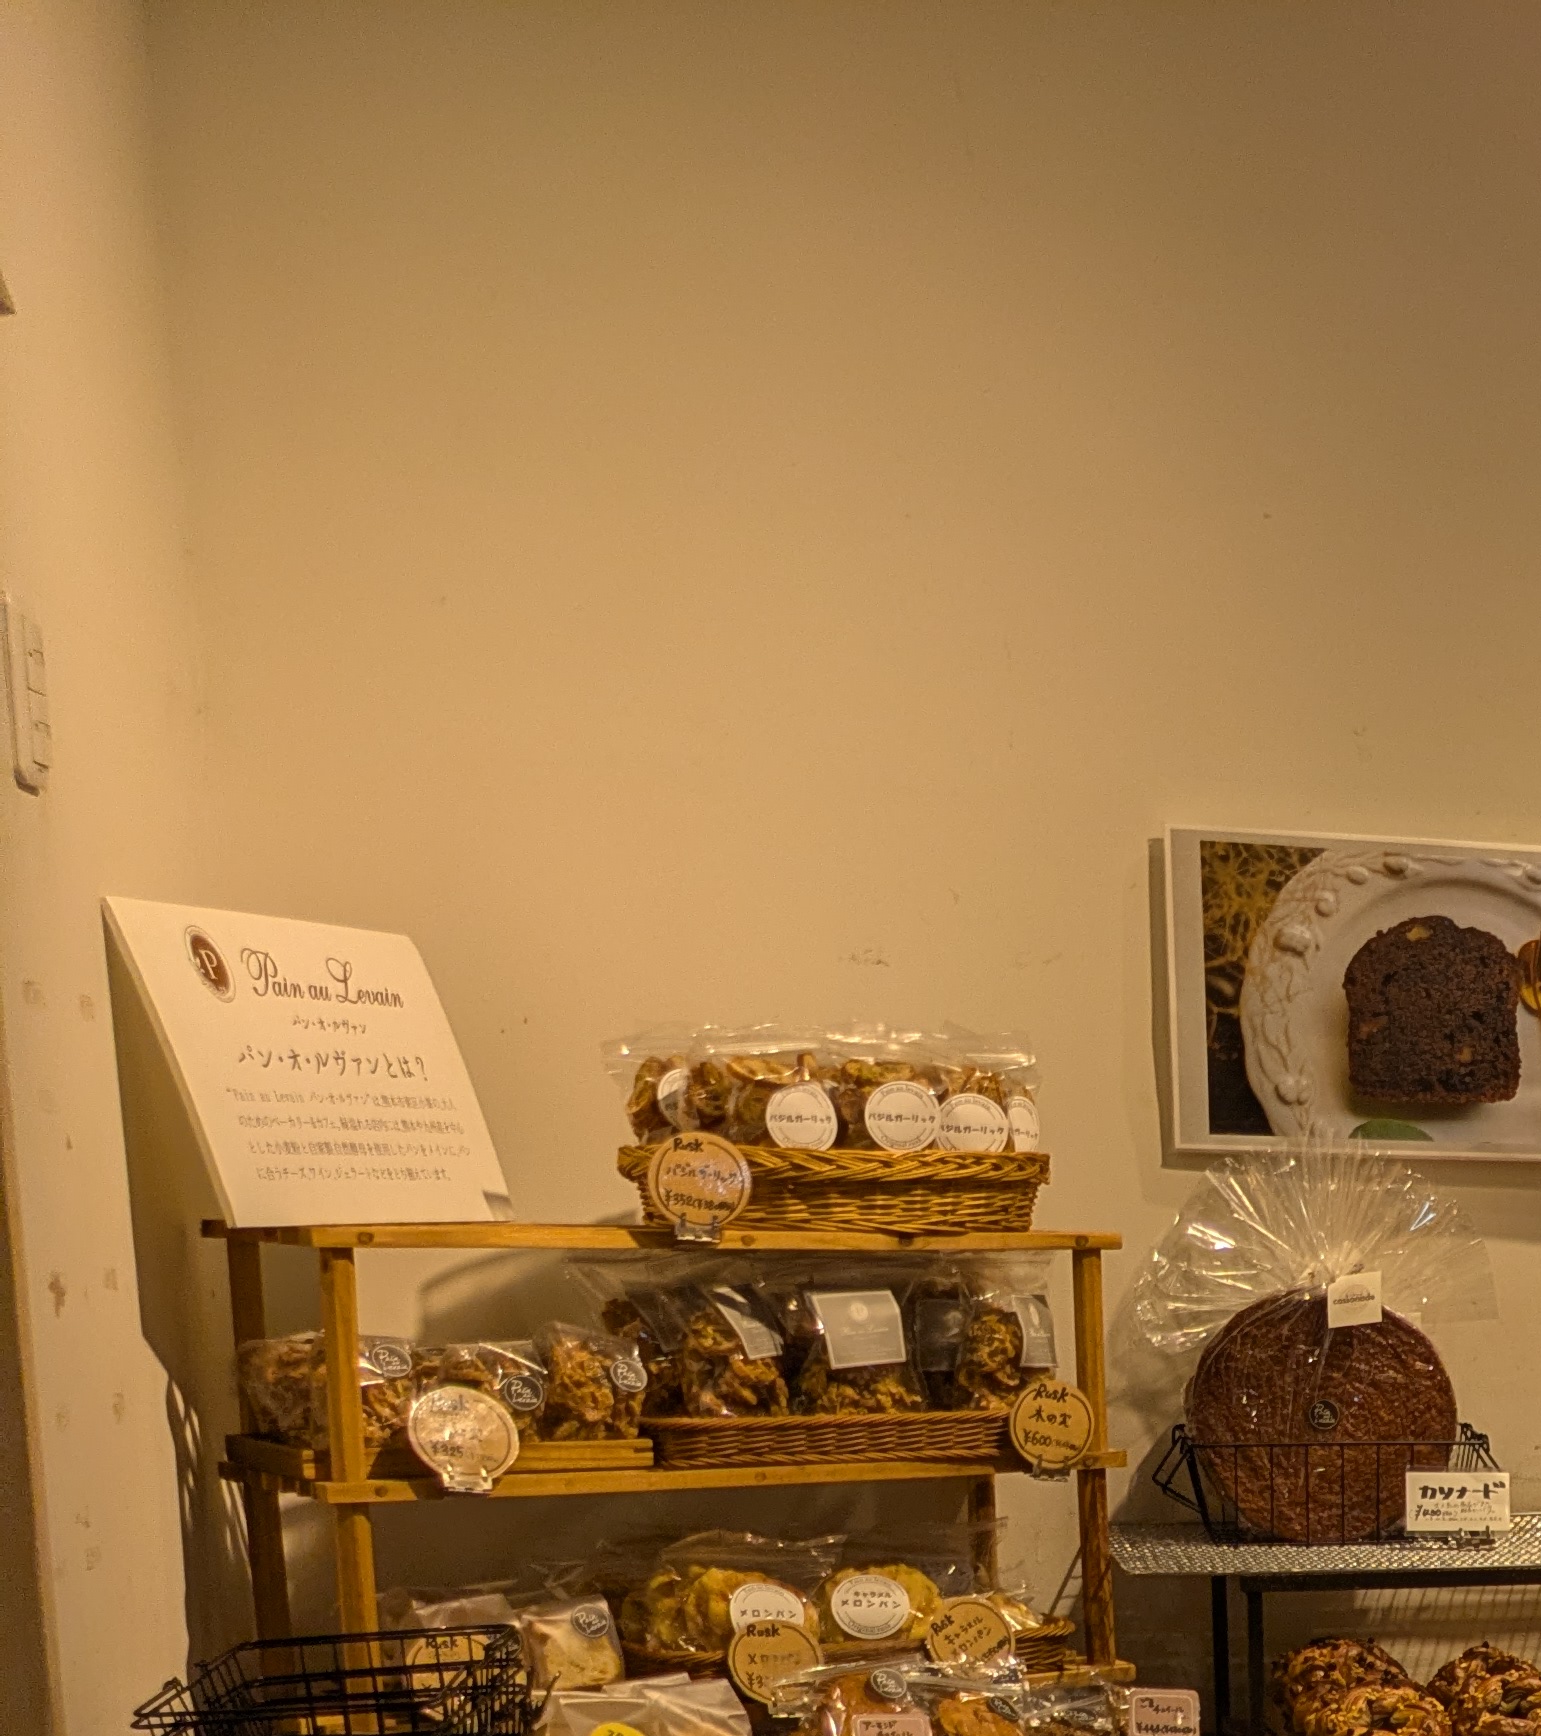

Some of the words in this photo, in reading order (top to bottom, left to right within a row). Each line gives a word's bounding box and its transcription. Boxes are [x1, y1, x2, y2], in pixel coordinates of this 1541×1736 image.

[240, 947, 305, 998] Pain
[308, 985, 332, 1003] au
[325, 957, 404, 1009] Levain
[869, 1113, 937, 1124] バジルガーリック
[673, 1138, 703, 1153] Rusk
[1032, 1383, 1069, 1404] Rusk
[1418, 1481, 1507, 1501] カソナード
[854, 1590, 893, 1600] キャラメル
[841, 1598, 902, 1610] メロンパン
[741, 1608, 798, 1619] メロンパン
[747, 1624, 782, 1638] Rusk
